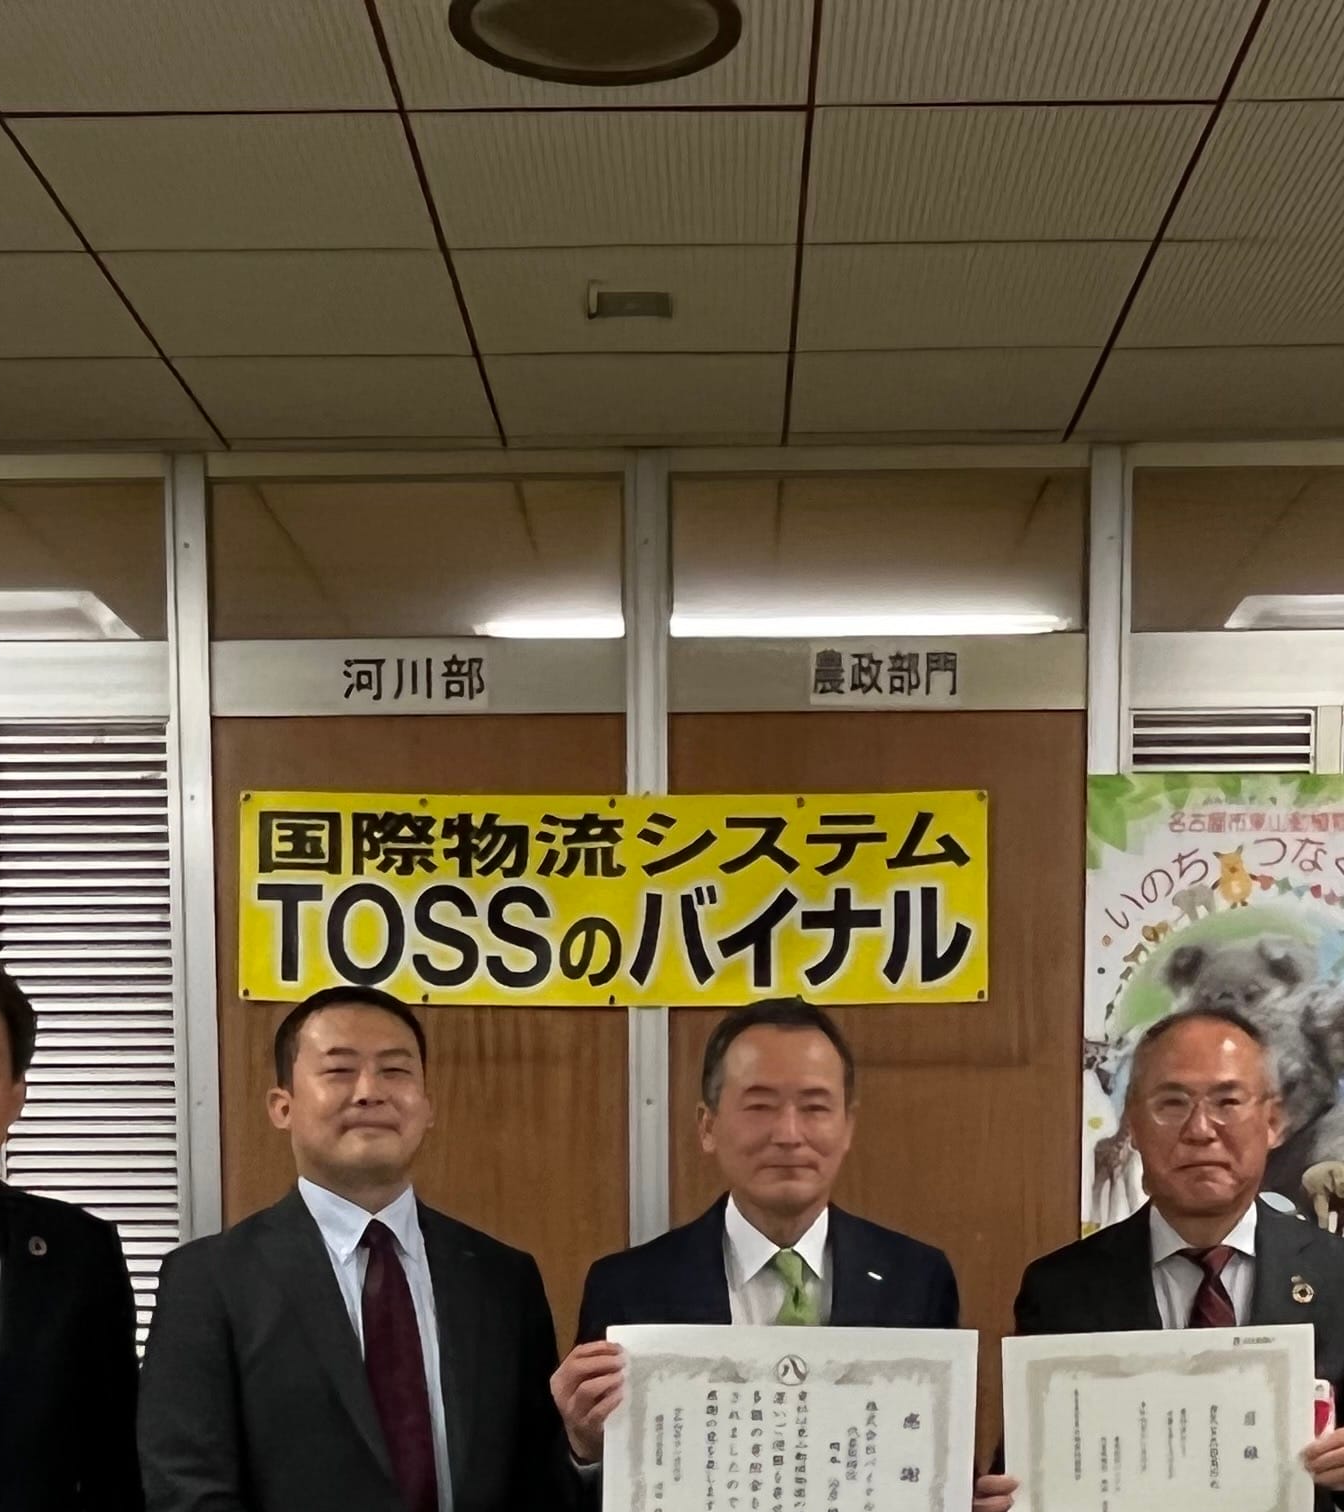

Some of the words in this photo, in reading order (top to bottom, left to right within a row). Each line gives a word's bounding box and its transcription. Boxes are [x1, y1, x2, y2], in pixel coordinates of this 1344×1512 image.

[343, 656, 485, 702] 河川部
[813, 650, 958, 696] 農政部門
[258, 811, 972, 878] 国際物流システム
[258, 884, 971, 989] TOSSのバイナル
